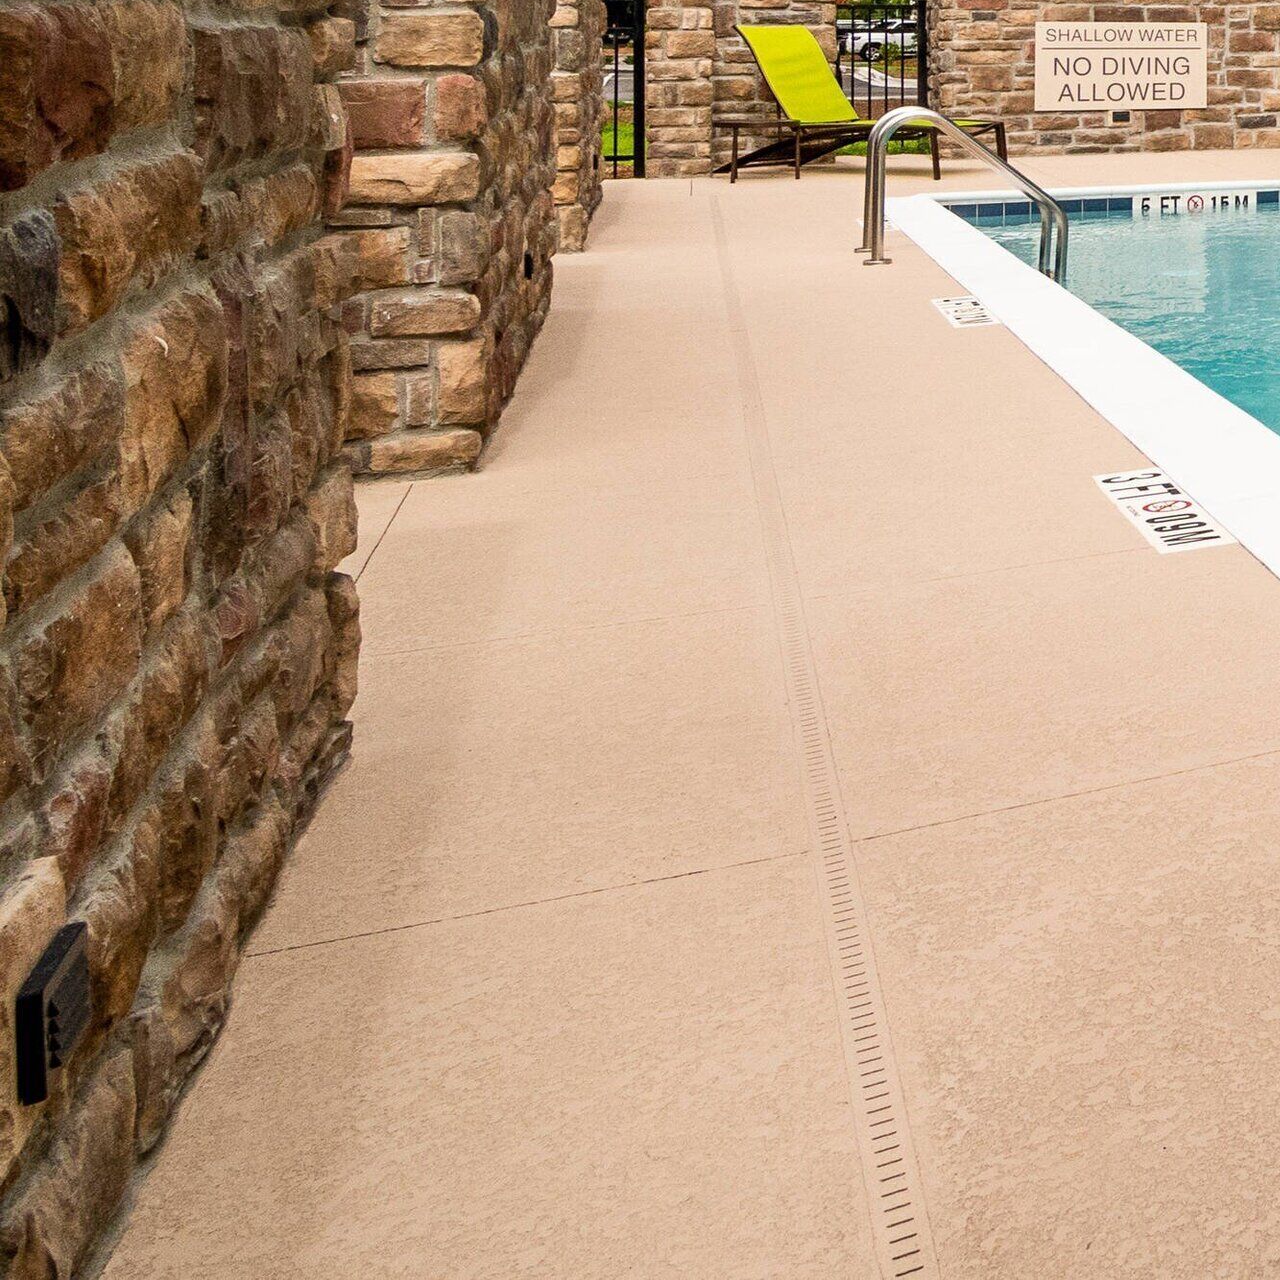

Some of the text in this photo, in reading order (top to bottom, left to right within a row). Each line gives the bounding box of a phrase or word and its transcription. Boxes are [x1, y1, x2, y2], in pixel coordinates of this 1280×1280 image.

[1045, 28, 1198, 43] SHALLOW WATER
[1053, 56, 1190, 76] NO DIVING
[1058, 82, 1186, 102] ALLOWED
[1160, 195, 1181, 213] FT
[1101, 472, 1162, 484] 3
[1109, 482, 1181, 501] FT
